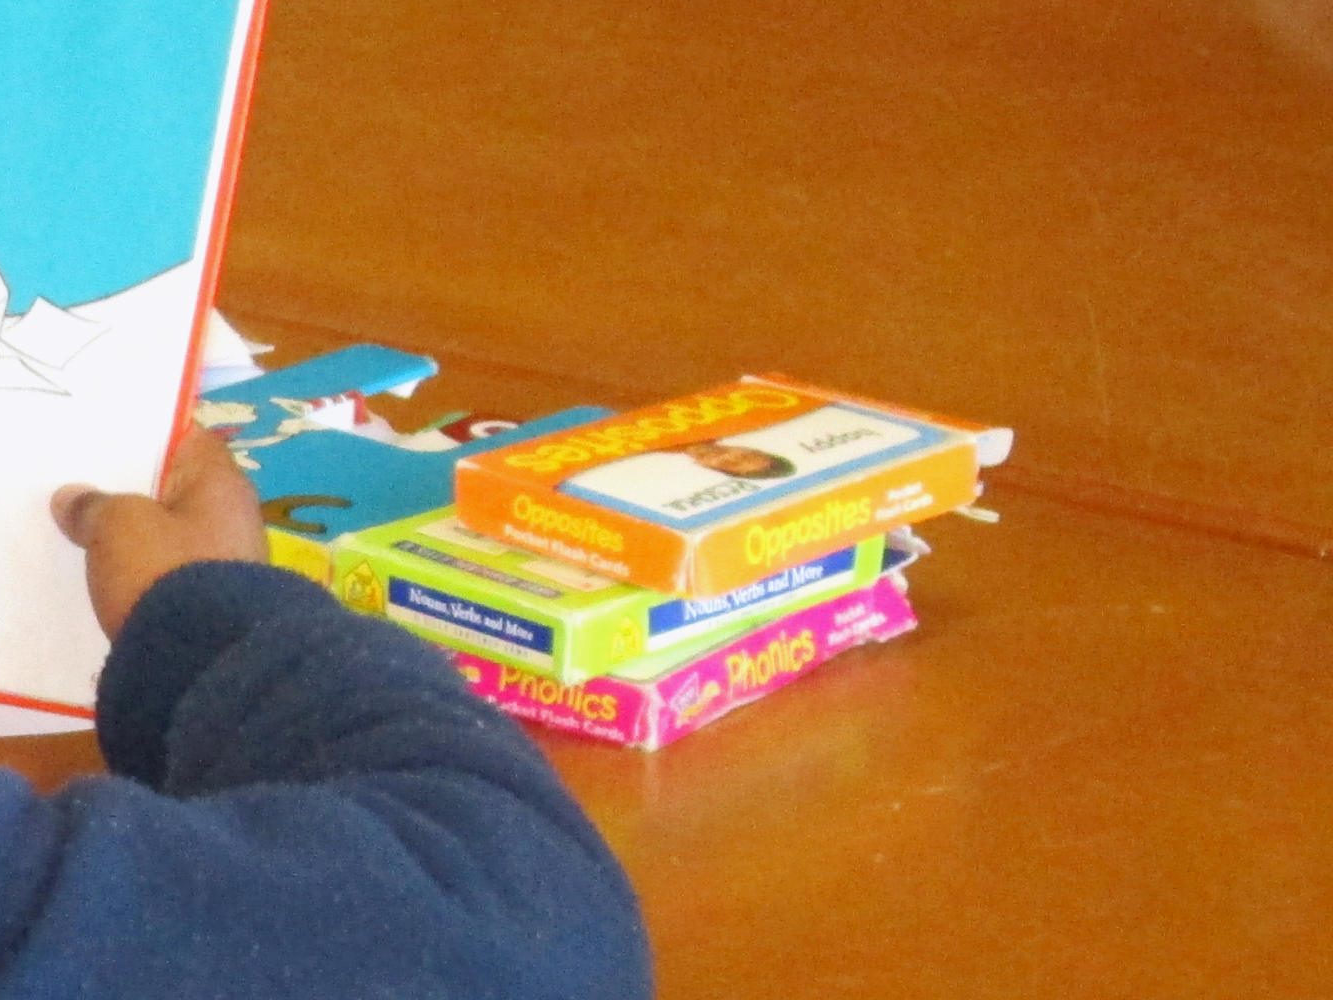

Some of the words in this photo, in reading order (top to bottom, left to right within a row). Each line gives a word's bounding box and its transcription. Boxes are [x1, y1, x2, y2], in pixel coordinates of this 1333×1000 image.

[504, 389, 799, 472] Opposites
[504, 523, 549, 549] Pocket
[550, 538, 587, 562] Flash
[589, 553, 630, 578] Cards
[513, 494, 624, 552] Opposites
[745, 496, 871, 568] Opposites
[409, 587, 448, 614] Nouns,
[452, 603, 482, 627] Verbs
[484, 617, 503, 631] and
[505, 621, 534, 641] More
[685, 598, 732, 621] Nouns,
[733, 582, 766, 606] Verbs
[767, 570, 789, 593] and
[791, 564, 824, 588] More
[725, 629, 815, 691] Phonics
[498, 664, 618, 722] Phonics
[539, 708, 580, 730] Flash
[582, 720, 625, 742] Cards
